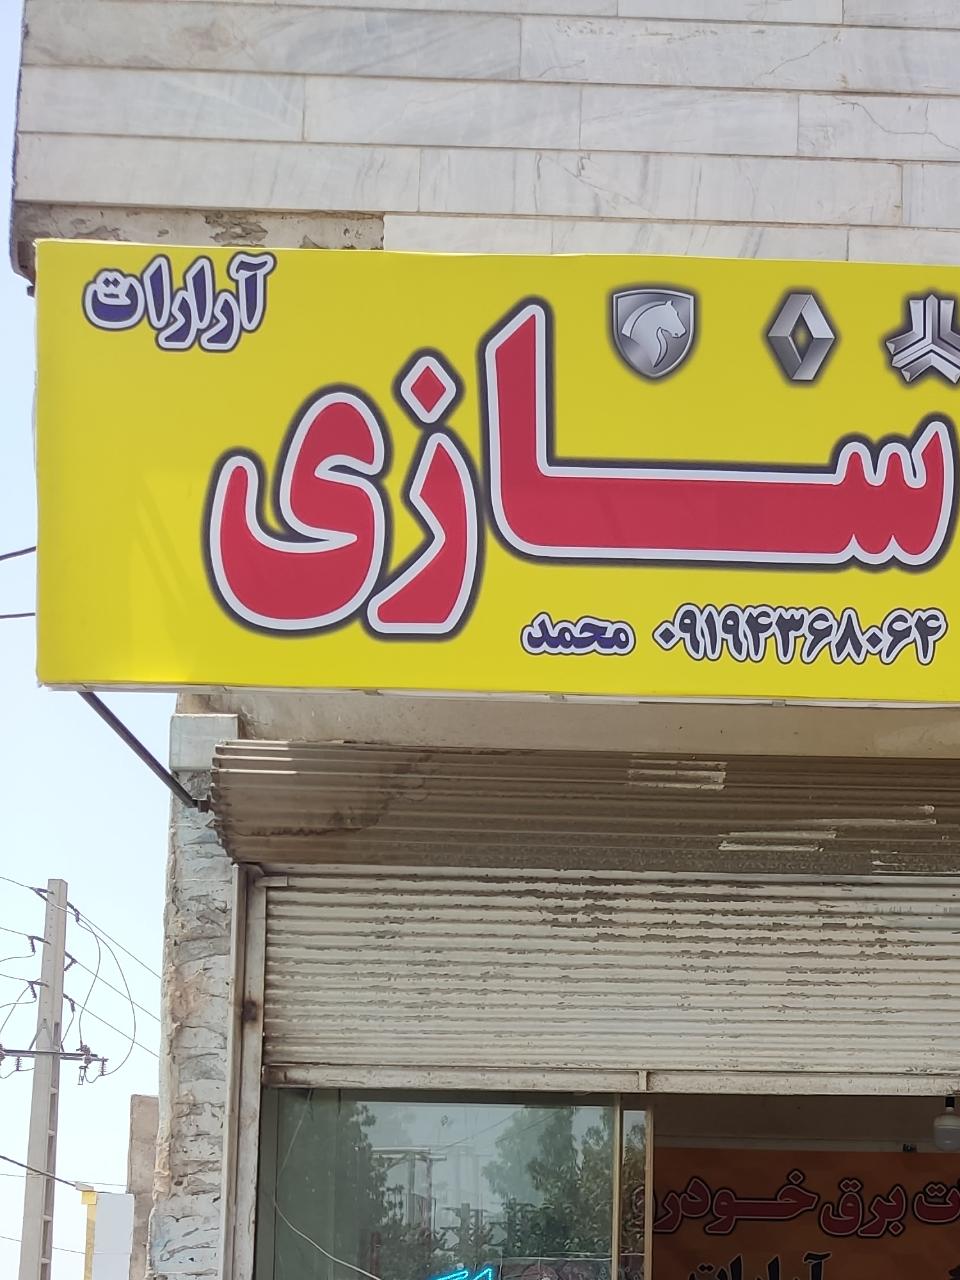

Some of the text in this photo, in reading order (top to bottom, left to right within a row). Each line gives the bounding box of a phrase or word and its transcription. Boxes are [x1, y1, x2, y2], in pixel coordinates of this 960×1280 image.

[82, 253, 277, 352] آرارات
[204, 296, 960, 641] سازی
[520, 603, 946, 664] ۰۹۱۹۴۳۶۸۰۶۴ محمد
[820, 1178, 906, 1237] برق
